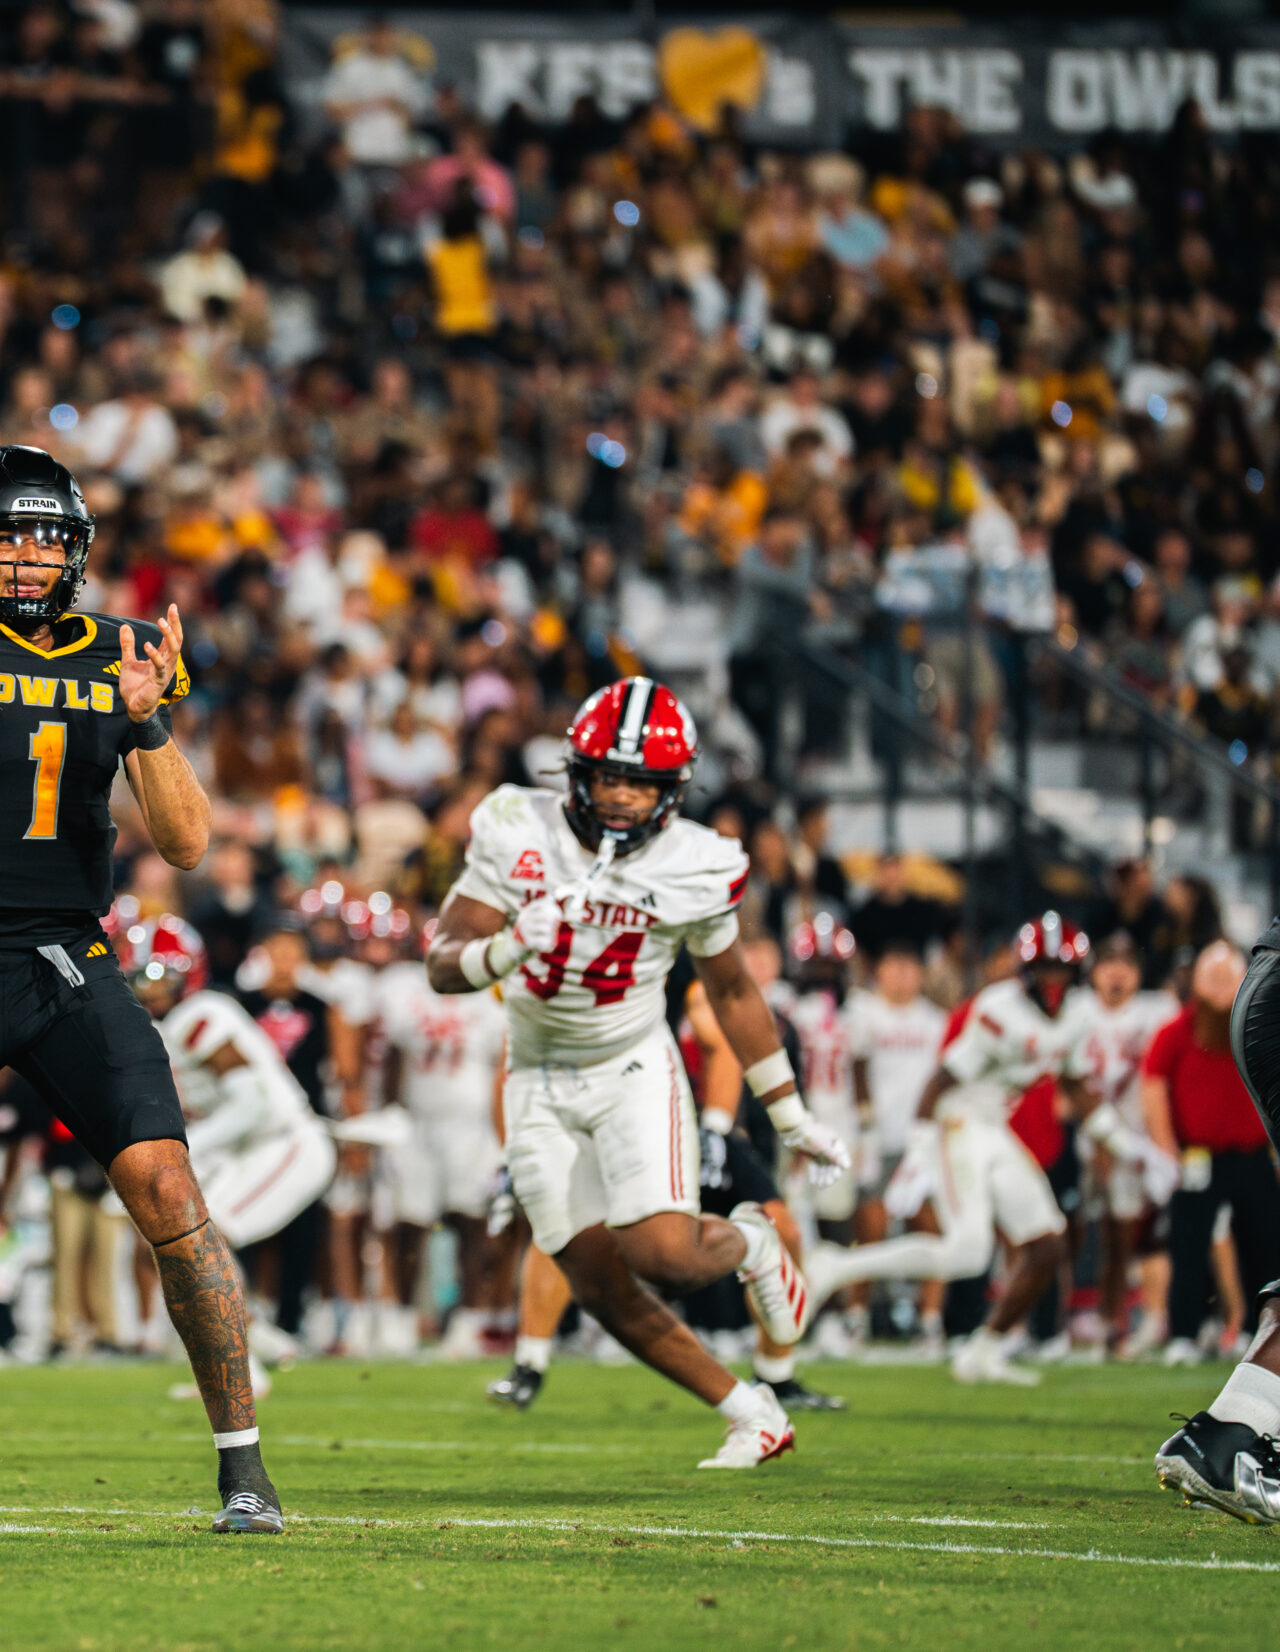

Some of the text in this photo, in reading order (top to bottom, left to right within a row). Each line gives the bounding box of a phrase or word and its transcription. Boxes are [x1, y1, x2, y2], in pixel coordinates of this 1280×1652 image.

[850, 47, 1023, 131] THE
[1046, 49, 1280, 132] OWLS
[18, 499, 57, 509] STRAIN
[22, 720, 67, 840] 1
